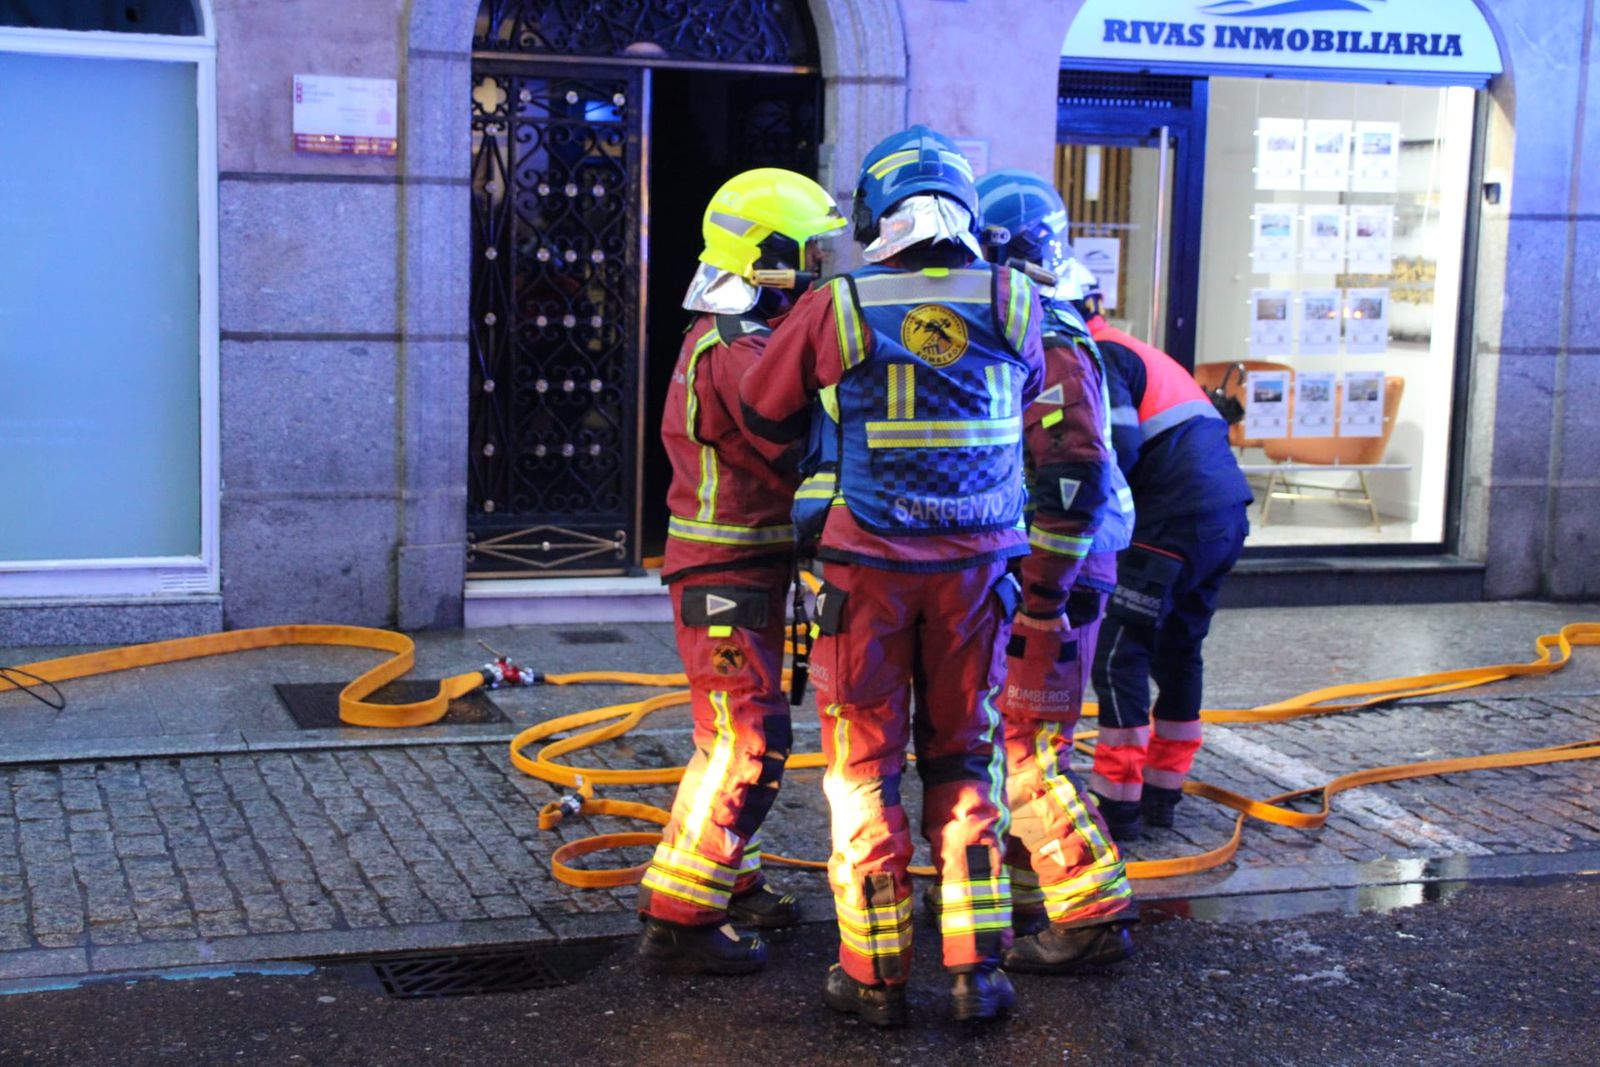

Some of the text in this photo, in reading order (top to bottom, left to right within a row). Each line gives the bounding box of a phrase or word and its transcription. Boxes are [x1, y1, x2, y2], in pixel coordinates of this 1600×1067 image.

[1103, 19, 1463, 56] RIVAS INMOBILIARIA
[894, 493, 1003, 525] SARGENTO
[1007, 685, 1070, 703] BOMBEROS
